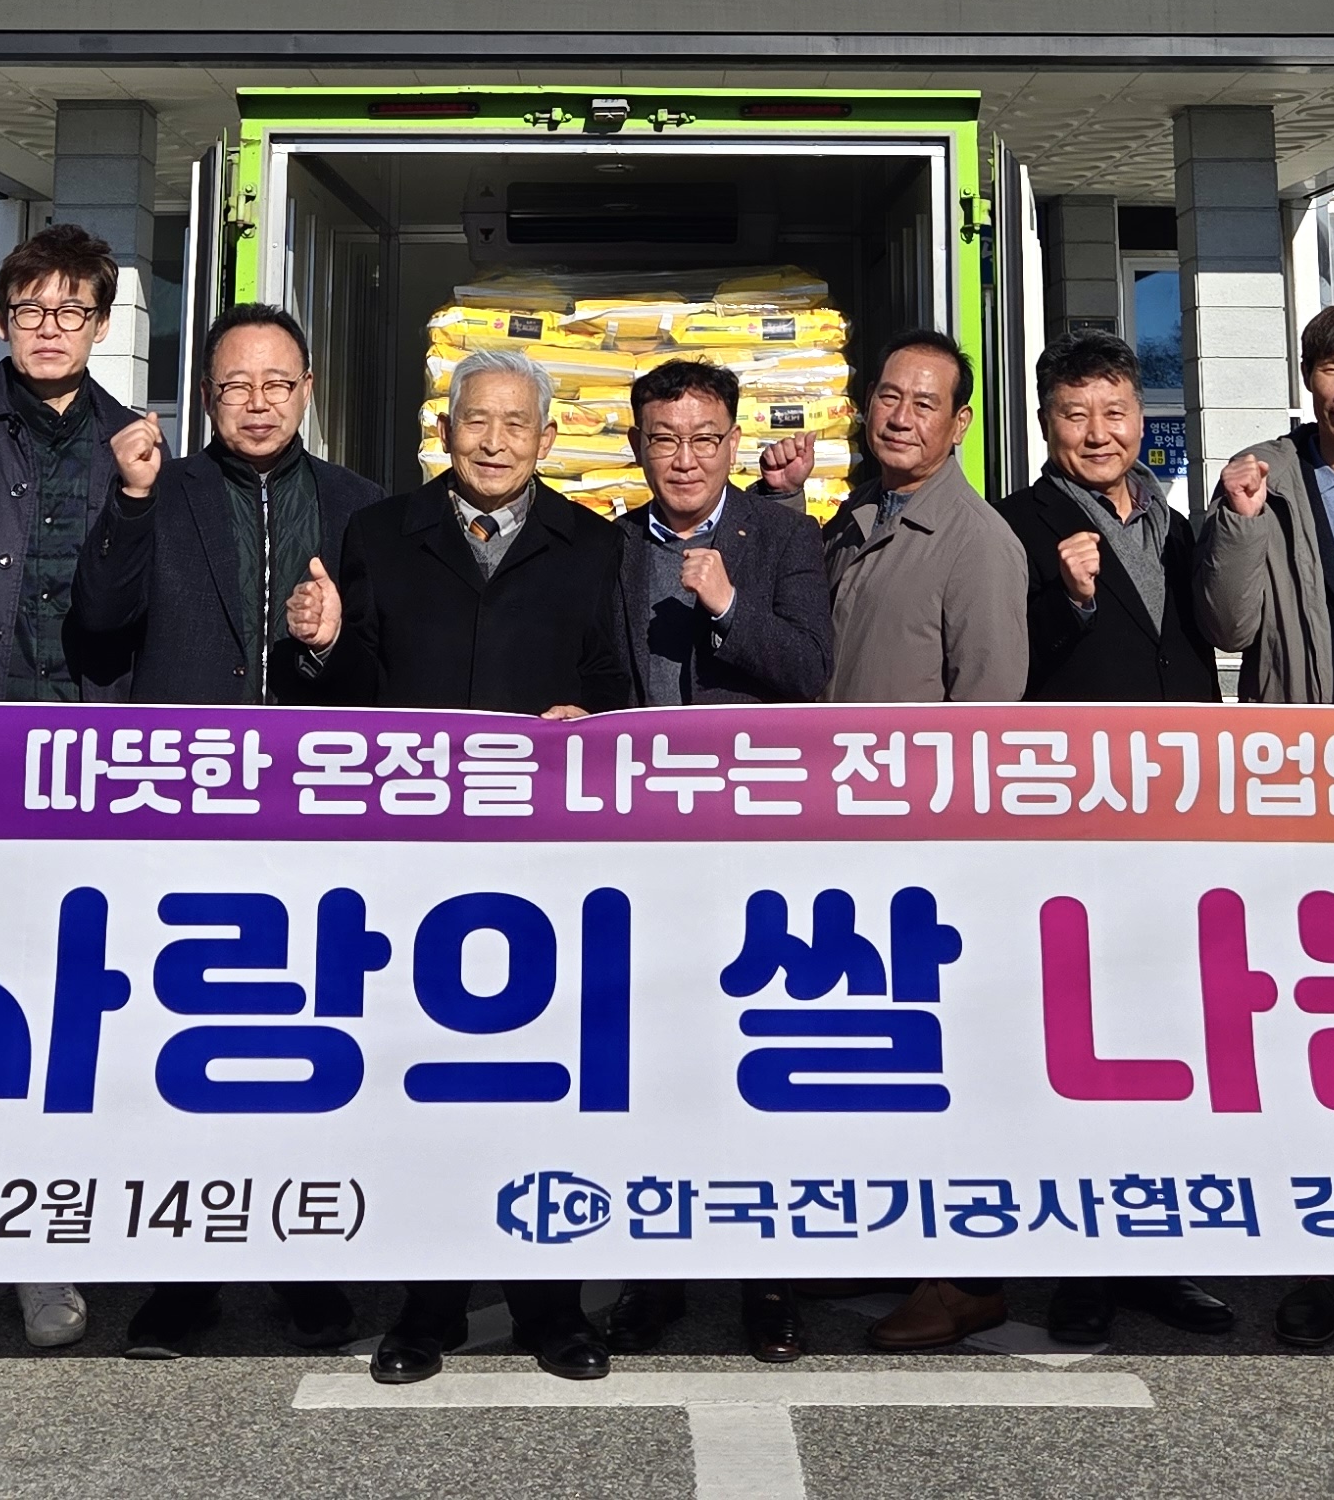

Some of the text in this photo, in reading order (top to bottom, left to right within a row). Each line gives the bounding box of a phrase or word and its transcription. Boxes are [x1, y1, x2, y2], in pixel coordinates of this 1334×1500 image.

[23, 726, 274, 815] 따뜻한
[292, 729, 539, 816] 온정을
[564, 731, 808, 817] 나누는
[719, 885, 963, 1113] 쌀
[123, 1177, 254, 1243] 14일
[270, 1177, 367, 1244] (토)
[625, 1172, 1262, 1241] 한국전기공사협회
